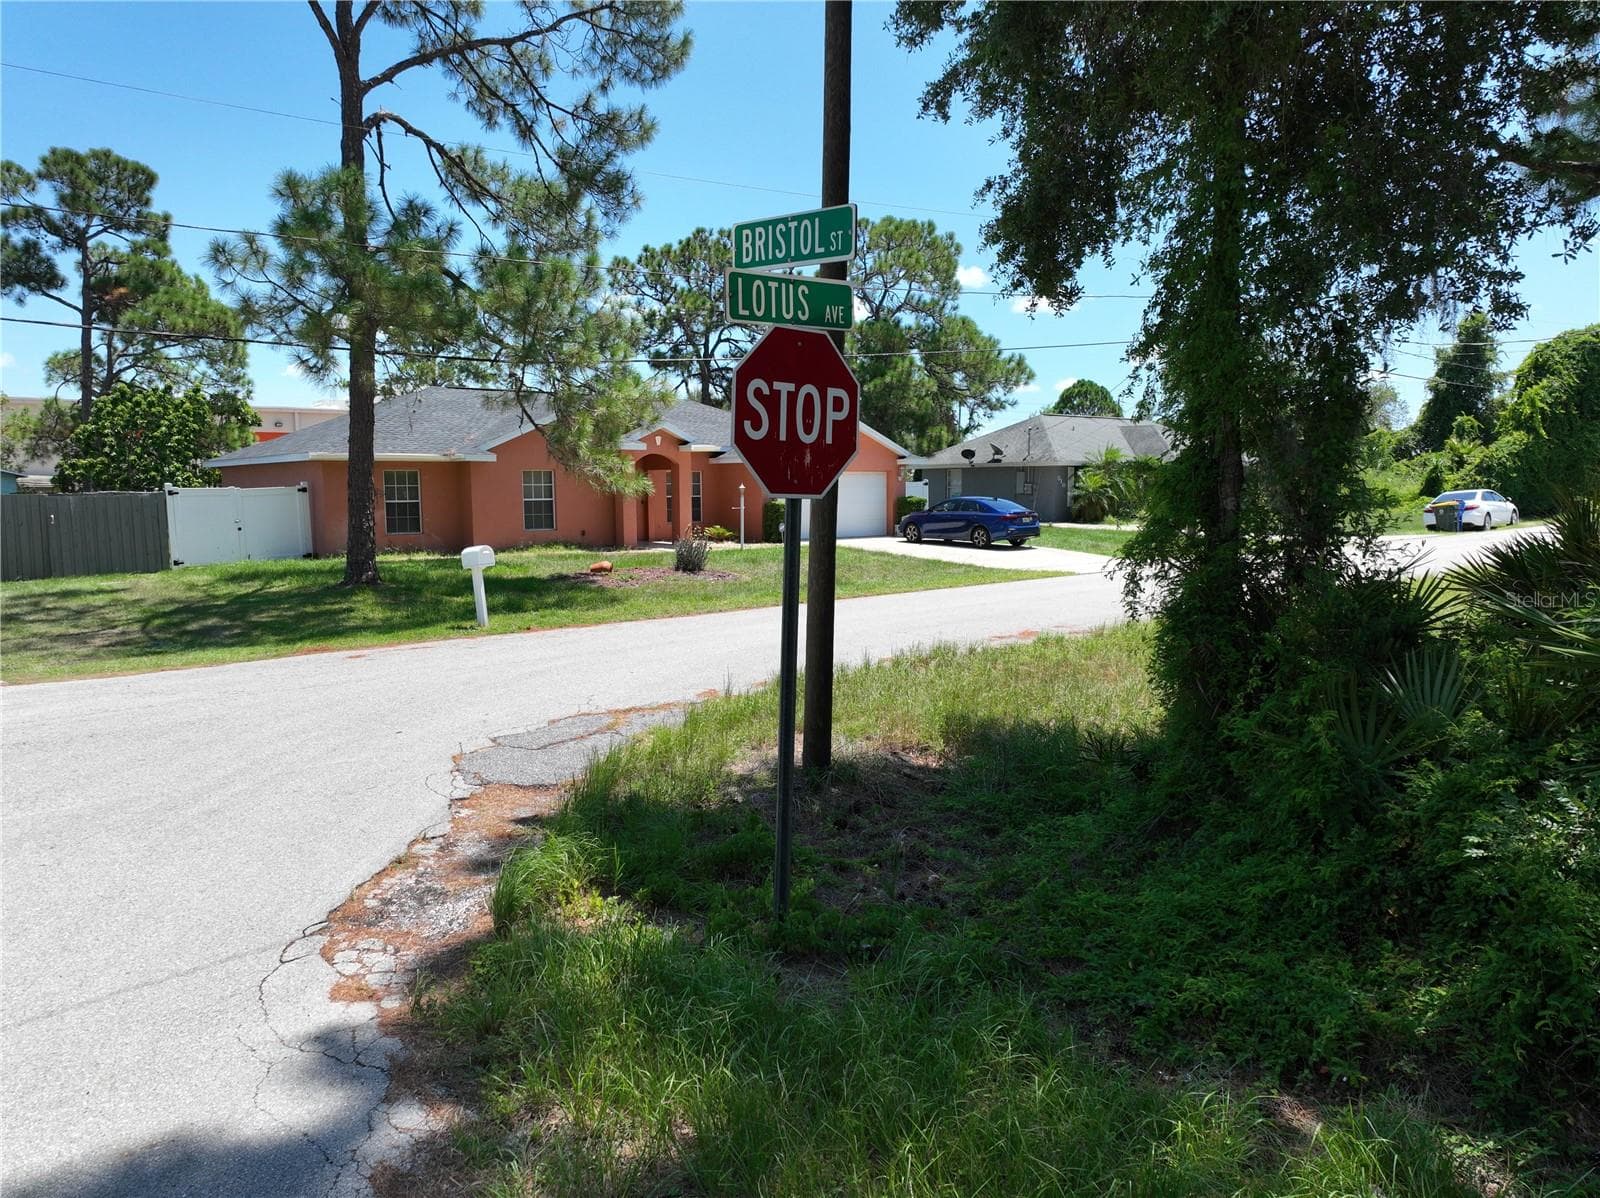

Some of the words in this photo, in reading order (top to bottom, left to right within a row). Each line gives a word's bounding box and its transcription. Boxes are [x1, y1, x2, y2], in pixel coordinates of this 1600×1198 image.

[742, 217, 825, 264] BRISTOL
[830, 230, 843, 252] ST
[738, 277, 810, 321] LOTUS
[825, 304, 845, 325] AVE
[743, 378, 850, 445] STOP
